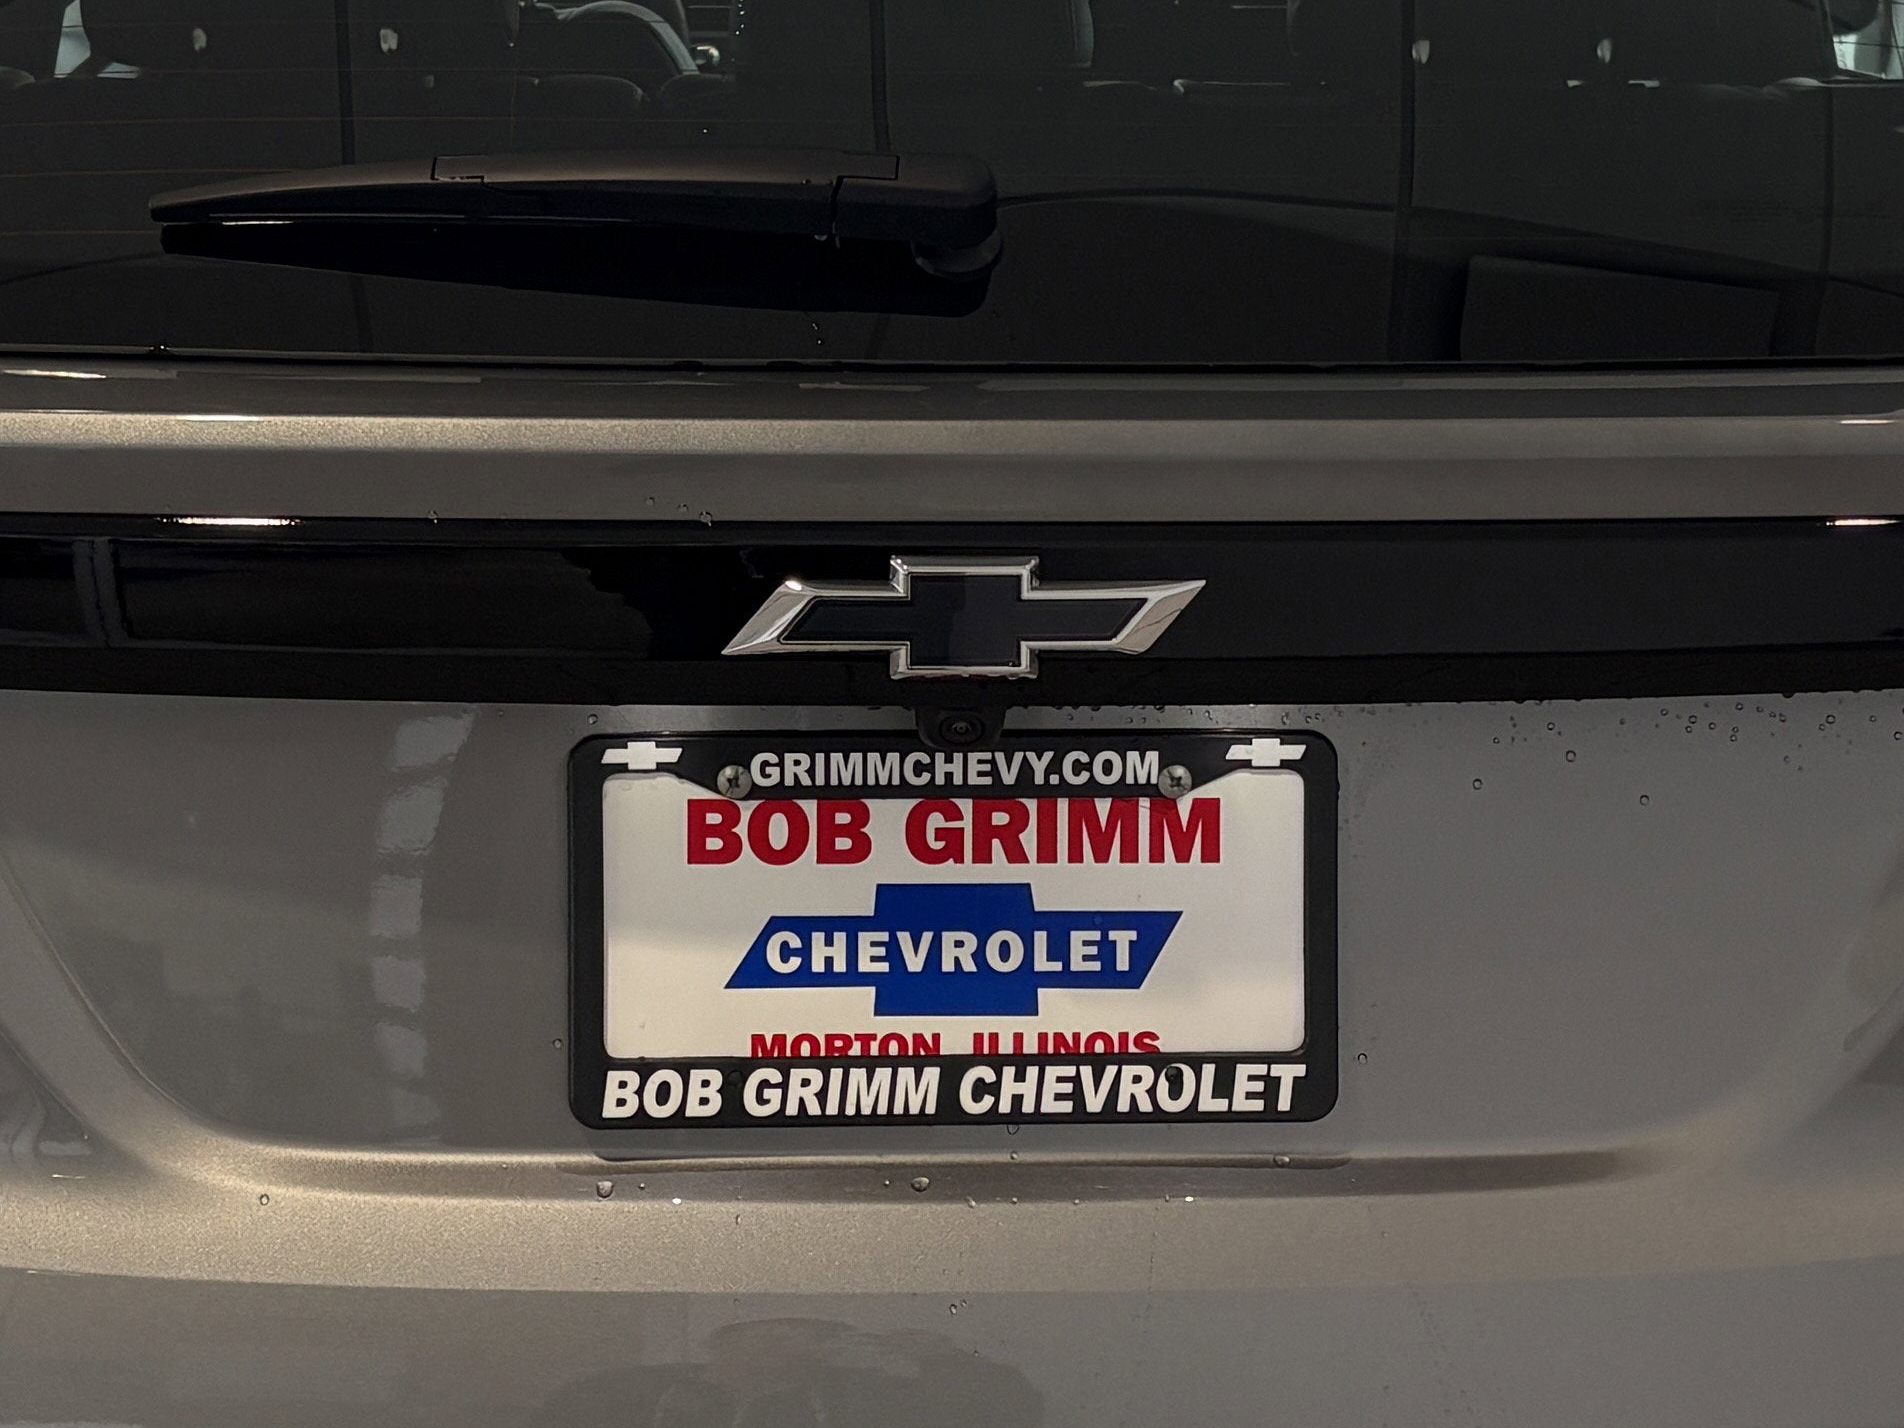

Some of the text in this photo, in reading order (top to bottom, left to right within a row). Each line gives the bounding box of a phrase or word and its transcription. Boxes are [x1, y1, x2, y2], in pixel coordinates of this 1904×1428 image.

[749, 750, 1159, 787] GRIMMCHEVY.COM
[686, 797, 1221, 865] BOB GRIMM
[766, 929, 1137, 974] CHEVROLET
[601, 1063, 1307, 1119] BOB GRIMM CHEVROLET
